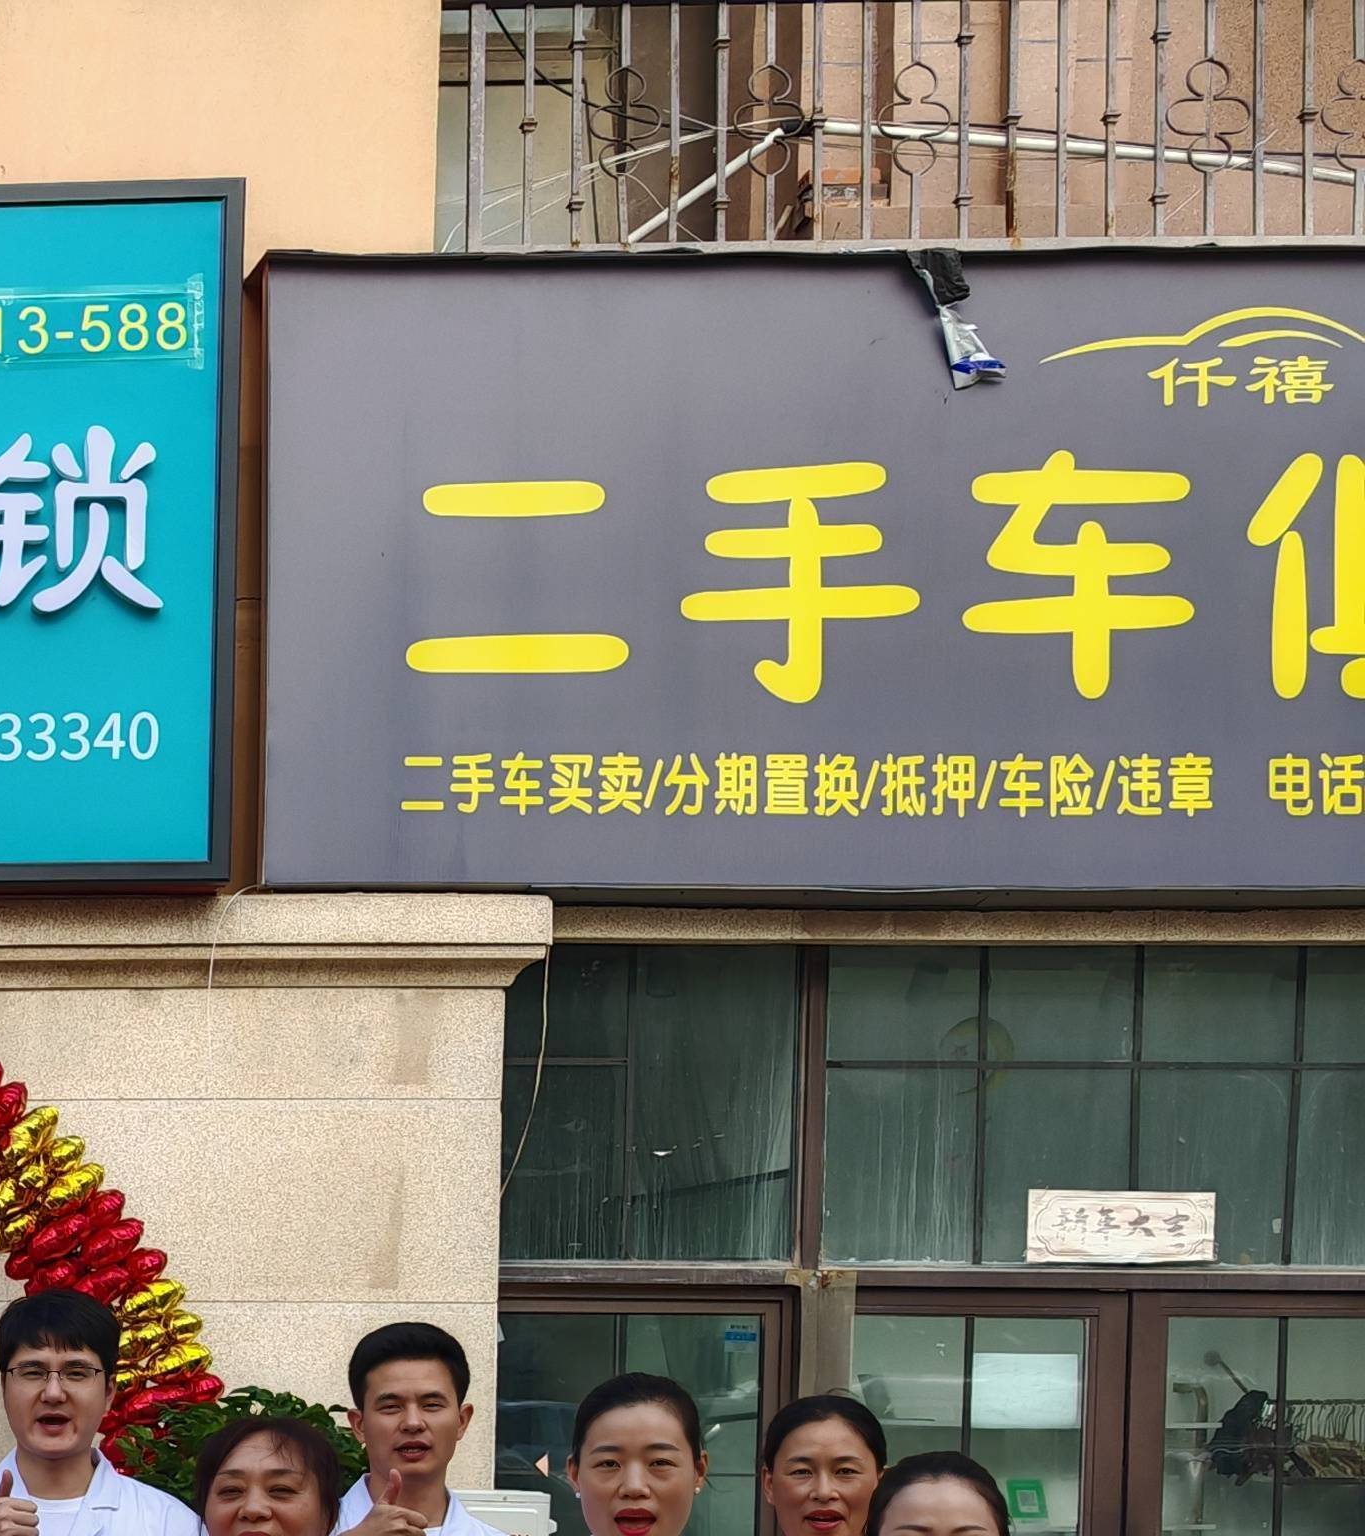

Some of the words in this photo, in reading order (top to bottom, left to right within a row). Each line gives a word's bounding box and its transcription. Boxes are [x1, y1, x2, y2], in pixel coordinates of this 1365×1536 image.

[1147, 356, 1335, 407] 仟禧
[402, 751, 1215, 818] 二手车买卖/分期置换/抵押/车险/违章
